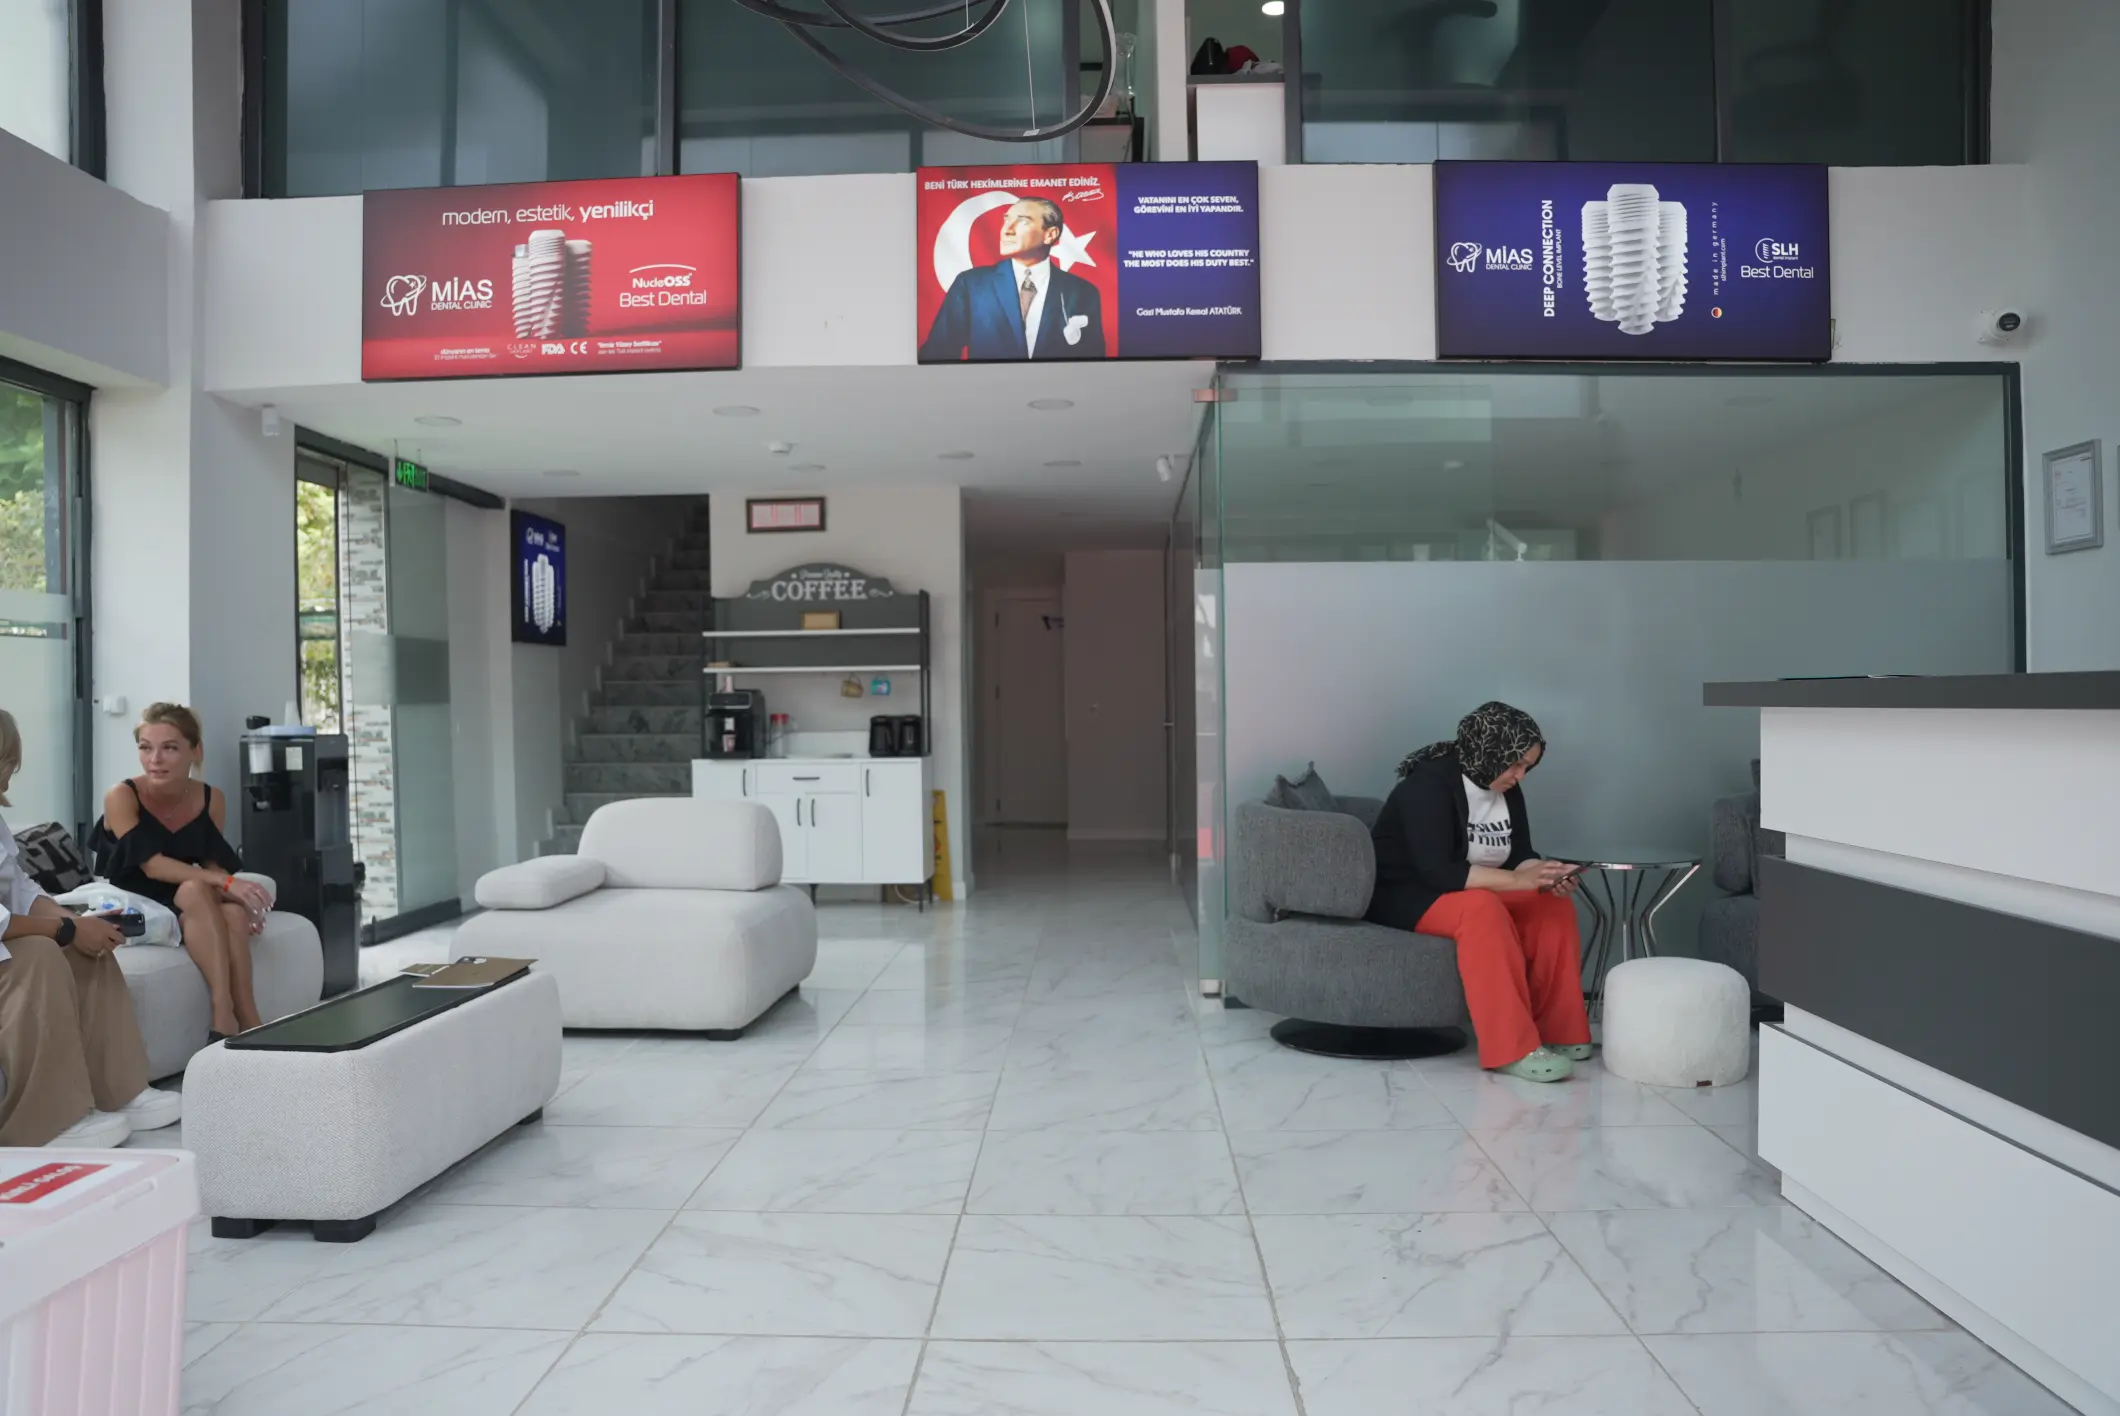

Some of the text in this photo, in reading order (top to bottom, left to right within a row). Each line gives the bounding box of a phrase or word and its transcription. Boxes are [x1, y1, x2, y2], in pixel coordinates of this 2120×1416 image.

[924, 176, 1101, 190] BENİ TÜRK HEKİMLERİNE EMANET EDİNİZ.
[1138, 196, 1239, 206] VATANINI EN ÇOK SEVEN,
[442, 199, 654, 226] modern, estetik, yenilikçi
[1133, 204, 1244, 214] GÖREVİNİ EN İYİ YAPANDIR.
[1711, 202, 1720, 247] germany
[1128, 249, 1250, 258] "HE WHO LOVES HIS COUNTRY
[1485, 245, 1534, 264] MİAS
[1771, 243, 1799, 256] SLH
[1123, 258, 1255, 268] THE MOST DOES HIS DUTY BEST."
[1541, 200, 1555, 317] DEEP CONNECTION
[1712, 253, 1718, 262] in
[1740, 265, 1814, 278] Best Dental
[431, 277, 493, 302] MİAS
[620, 289, 707, 307] Best Dental
[430, 300, 493, 311] DENTAL CLINIC
[1136, 305, 1242, 316] Gazi Mustafa Kemal ATATÜRK
[541, 343, 566, 355] FDA
[570, 341, 588, 355] CE
[771, 579, 869, 601] COFFEE
